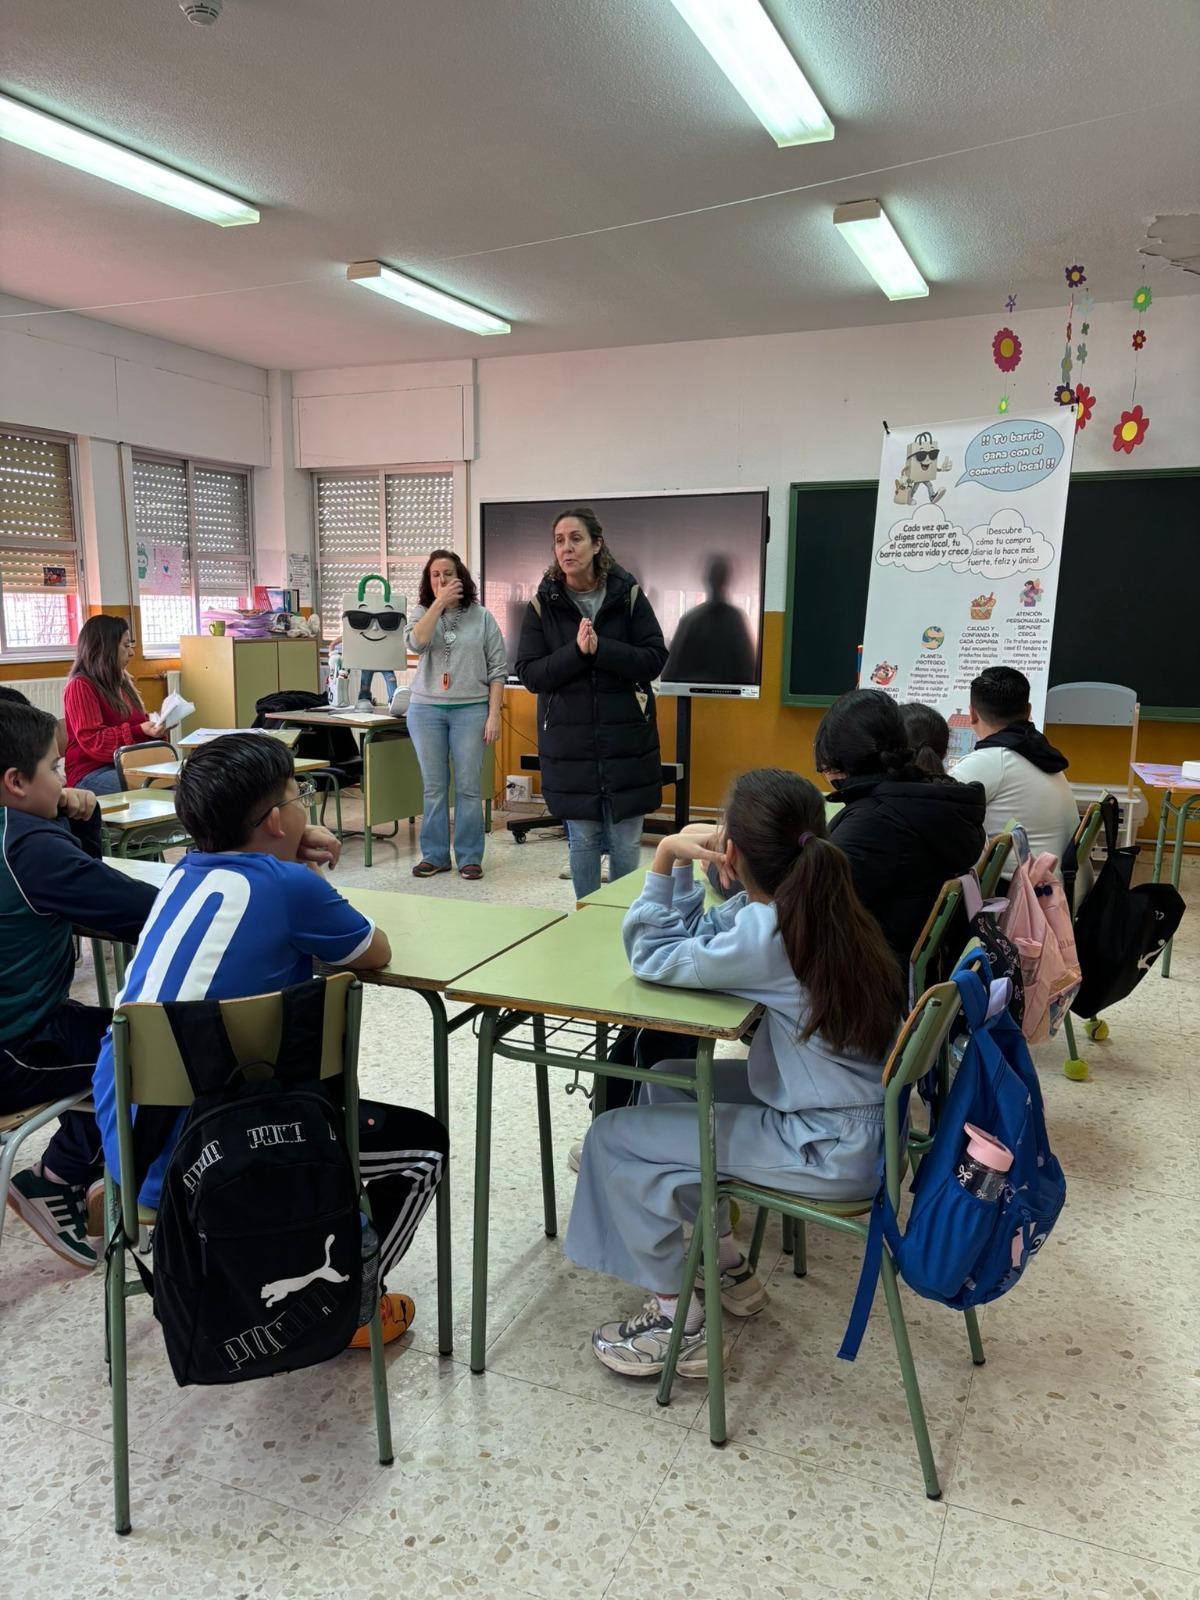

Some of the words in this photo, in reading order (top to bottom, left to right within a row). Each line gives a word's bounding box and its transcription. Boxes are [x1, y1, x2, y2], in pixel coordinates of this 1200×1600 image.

[993, 434, 1008, 444] Tu
[1010, 429, 1044, 442] barrio
[983, 450, 1008, 462] gana
[1010, 448, 1030, 458] con
[1032, 444, 1044, 455] el
[969, 462, 1015, 476] comercio
[1018, 459, 1044, 472] local
[903, 523, 920, 532] Cada
[936, 524, 949, 532] que
[987, 526, 1022, 535] ¡Descubre
[894, 534, 914, 542] eliges
[916, 532, 946, 541] comprar
[1005, 537, 1031, 545] compra
[932, 539, 950, 548] local,
[903, 549, 923, 557] cobra
[942, 549, 946, 558] y
[114, 869, 250, 1013] 10
[247, 1122, 306, 1149] PUMA
